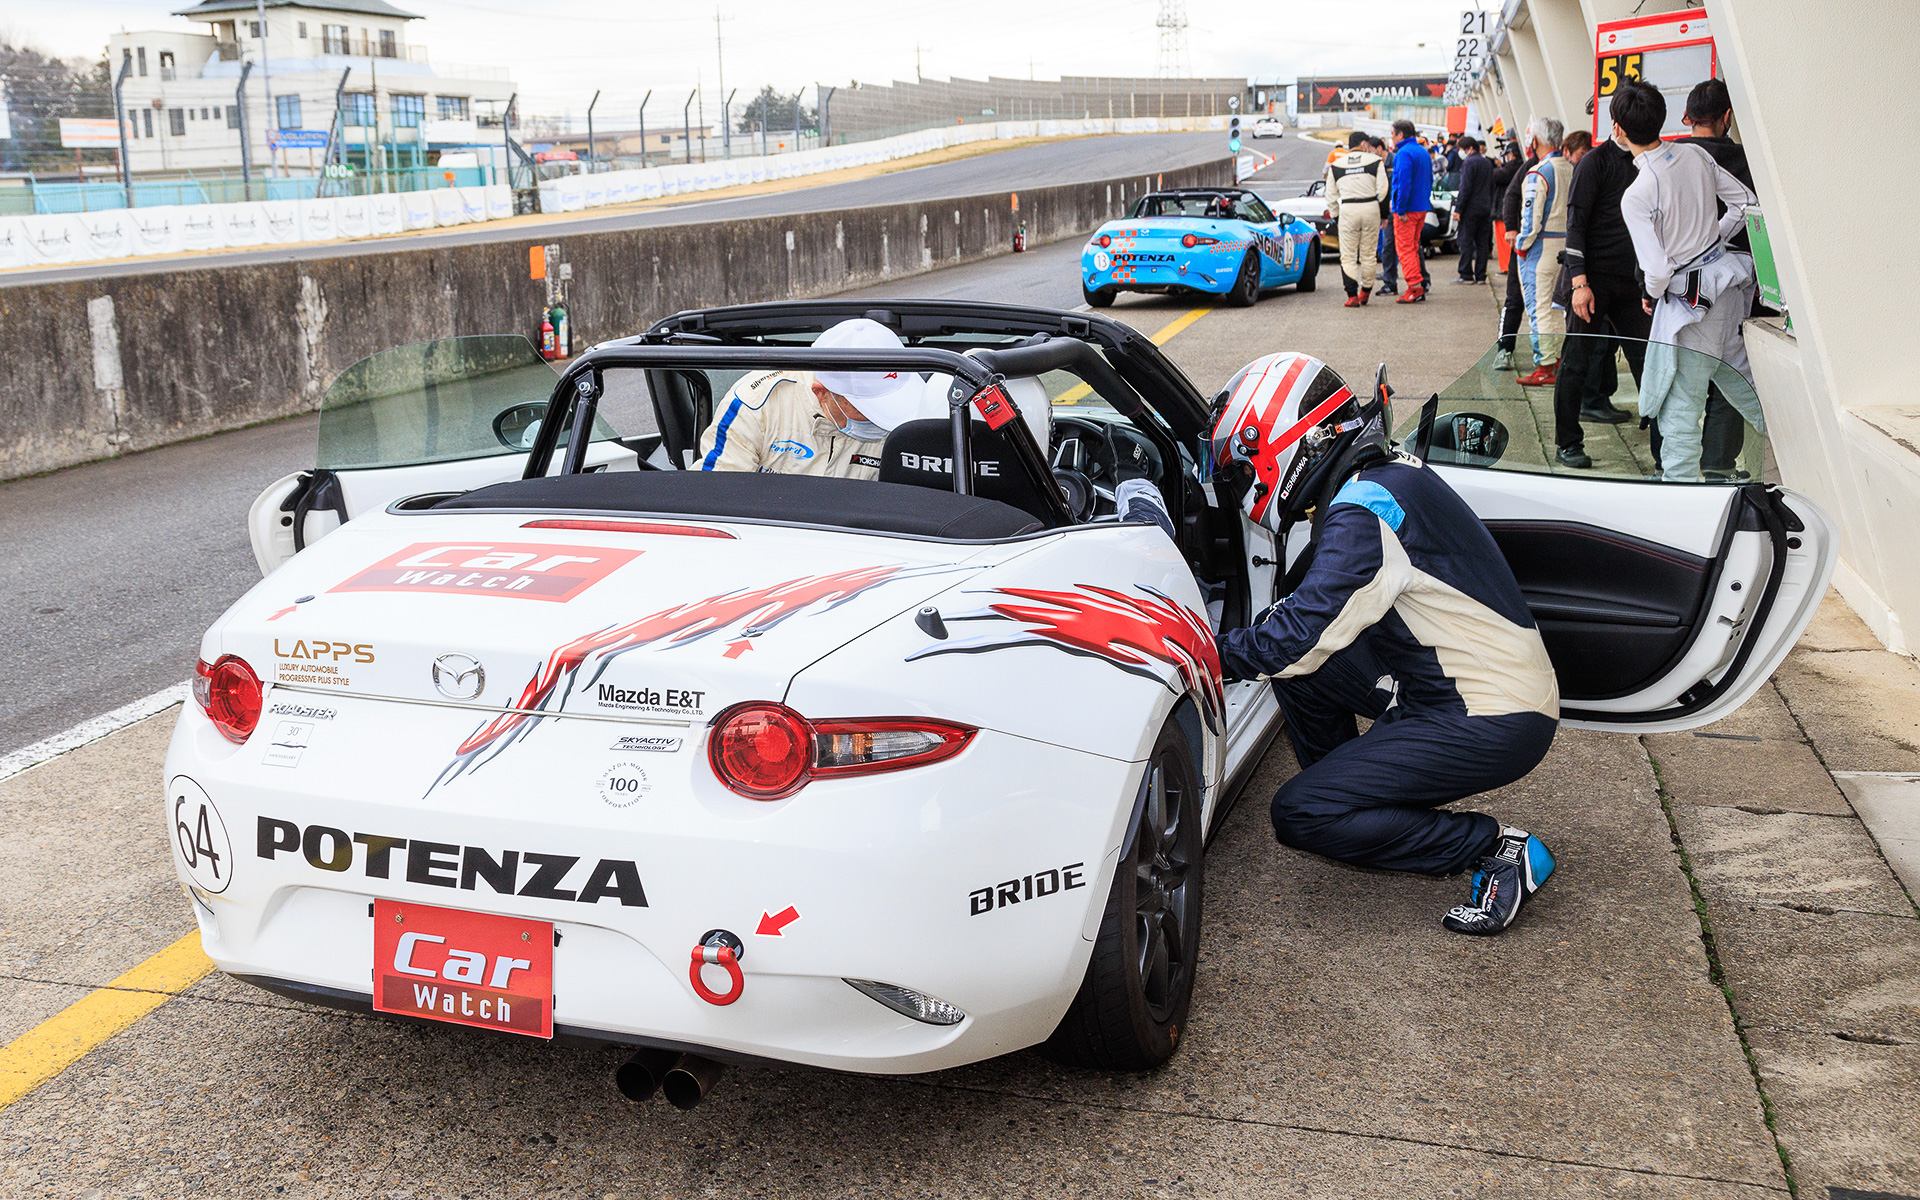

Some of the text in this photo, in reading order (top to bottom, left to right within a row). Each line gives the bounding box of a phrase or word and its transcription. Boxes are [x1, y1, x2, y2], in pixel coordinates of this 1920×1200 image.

[1462, 11, 1486, 34] 21
[1457, 38, 1479, 57] 22
[1454, 57, 1472, 72] 23
[1338, 85, 1414, 104] YOKOHAMA
[1113, 254, 1176, 262] POTENZA
[1285, 237, 1293, 262] 13
[1097, 254, 1108, 269] 13
[900, 451, 1000, 477] BRIE
[1285, 456, 1309, 493] ISHIKAWA
[396, 546, 600, 572] Car
[393, 569, 535, 591] Watch
[274, 638, 376, 664] LAPPS
[279, 663, 339, 675] LUXURY AUTOMOBILE
[279, 673, 350, 687] PROGRESSIVE PLUS STYLE
[598, 683, 706, 709] Mazda E&T
[268, 702, 338, 721] ROADSTER
[598, 701, 615, 709] Mazda
[615, 703, 645, 713] Engineering
[651, 706, 682, 715] Technology
[619, 736, 676, 746] SKYACTIV
[622, 744, 667, 752] TECHNOLOGY
[602, 762, 648, 782] MAZDA MOTOR
[609, 777, 639, 793] 100
[599, 789, 643, 809] CORPORATION
[175, 795, 221, 880] 64
[256, 815, 650, 908] POTENZA
[968, 861, 1087, 917] BRIDE
[393, 931, 532, 989] Car
[412, 983, 512, 1023] Watch
